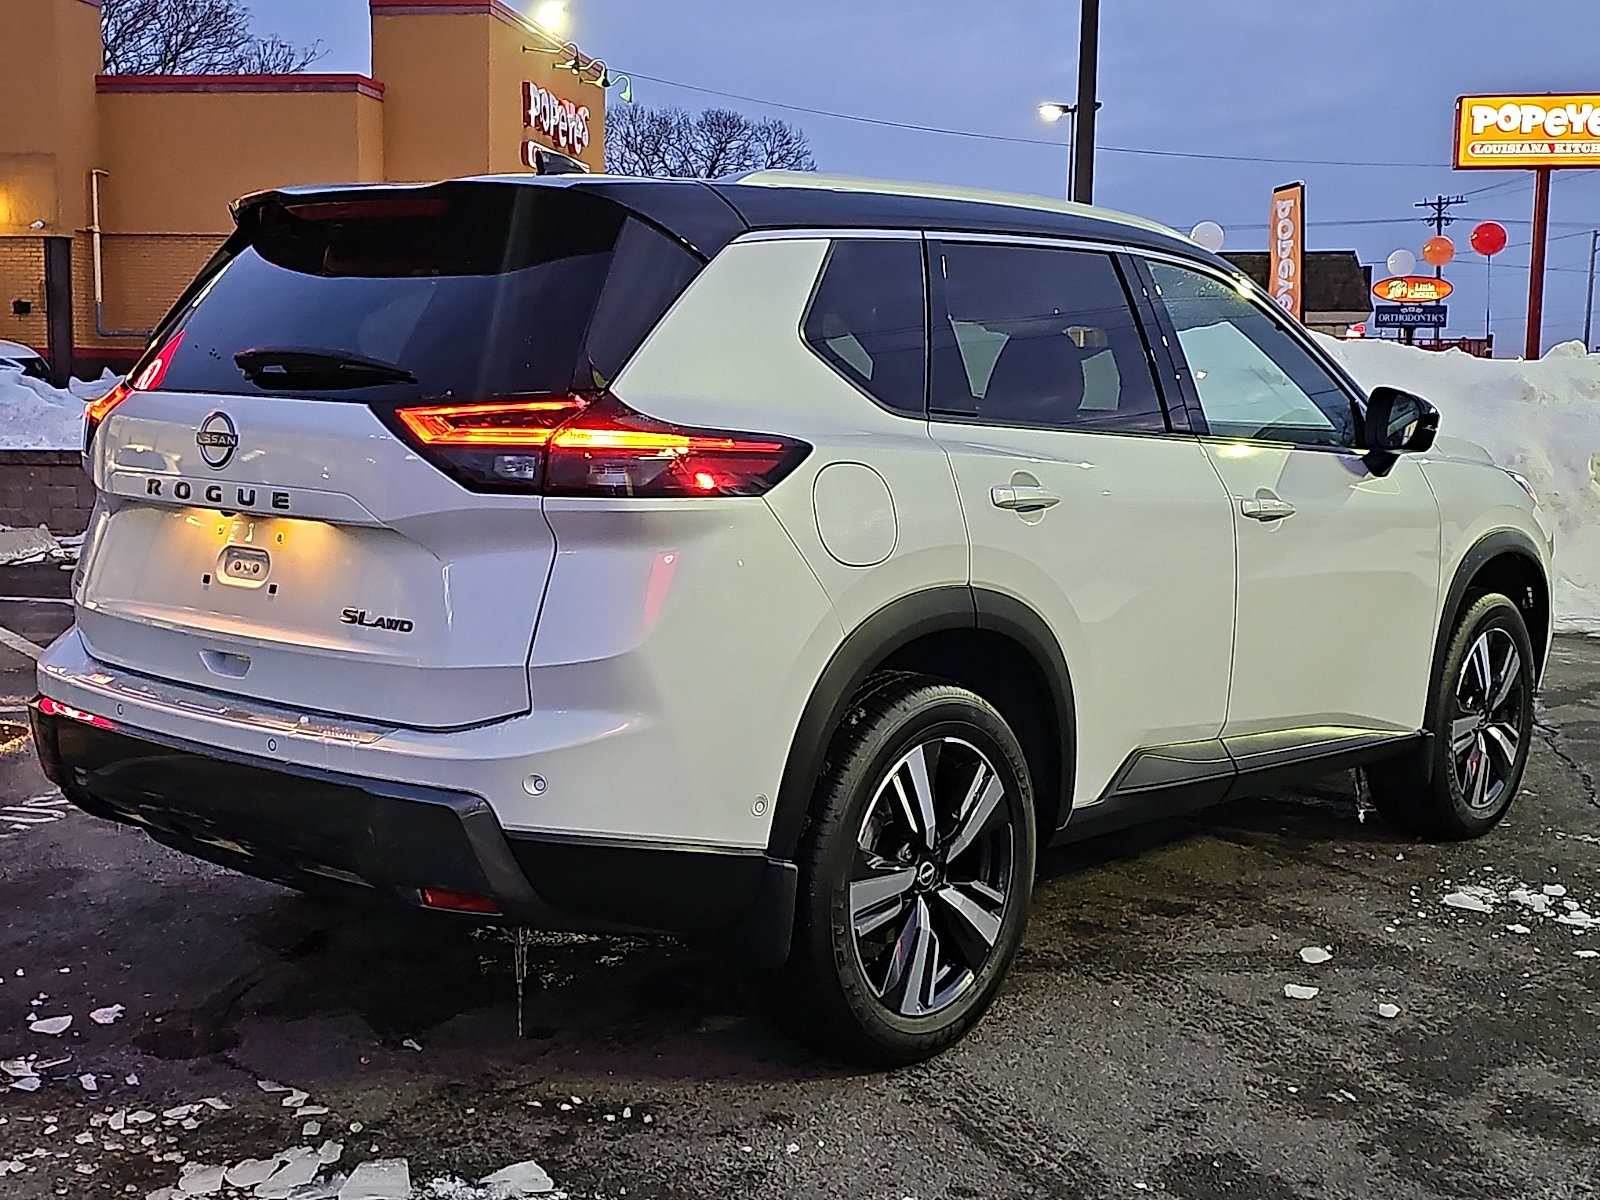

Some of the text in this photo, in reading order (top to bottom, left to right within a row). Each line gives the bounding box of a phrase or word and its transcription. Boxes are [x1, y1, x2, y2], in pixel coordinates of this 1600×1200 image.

[1474, 143, 1551, 154] LOUISIANA
[1414, 282, 1436, 292] Little
[1378, 313, 1445, 322] ORTHODONTICS
[198, 432, 237, 446] SSAN
[146, 479, 291, 510] ROGUE
